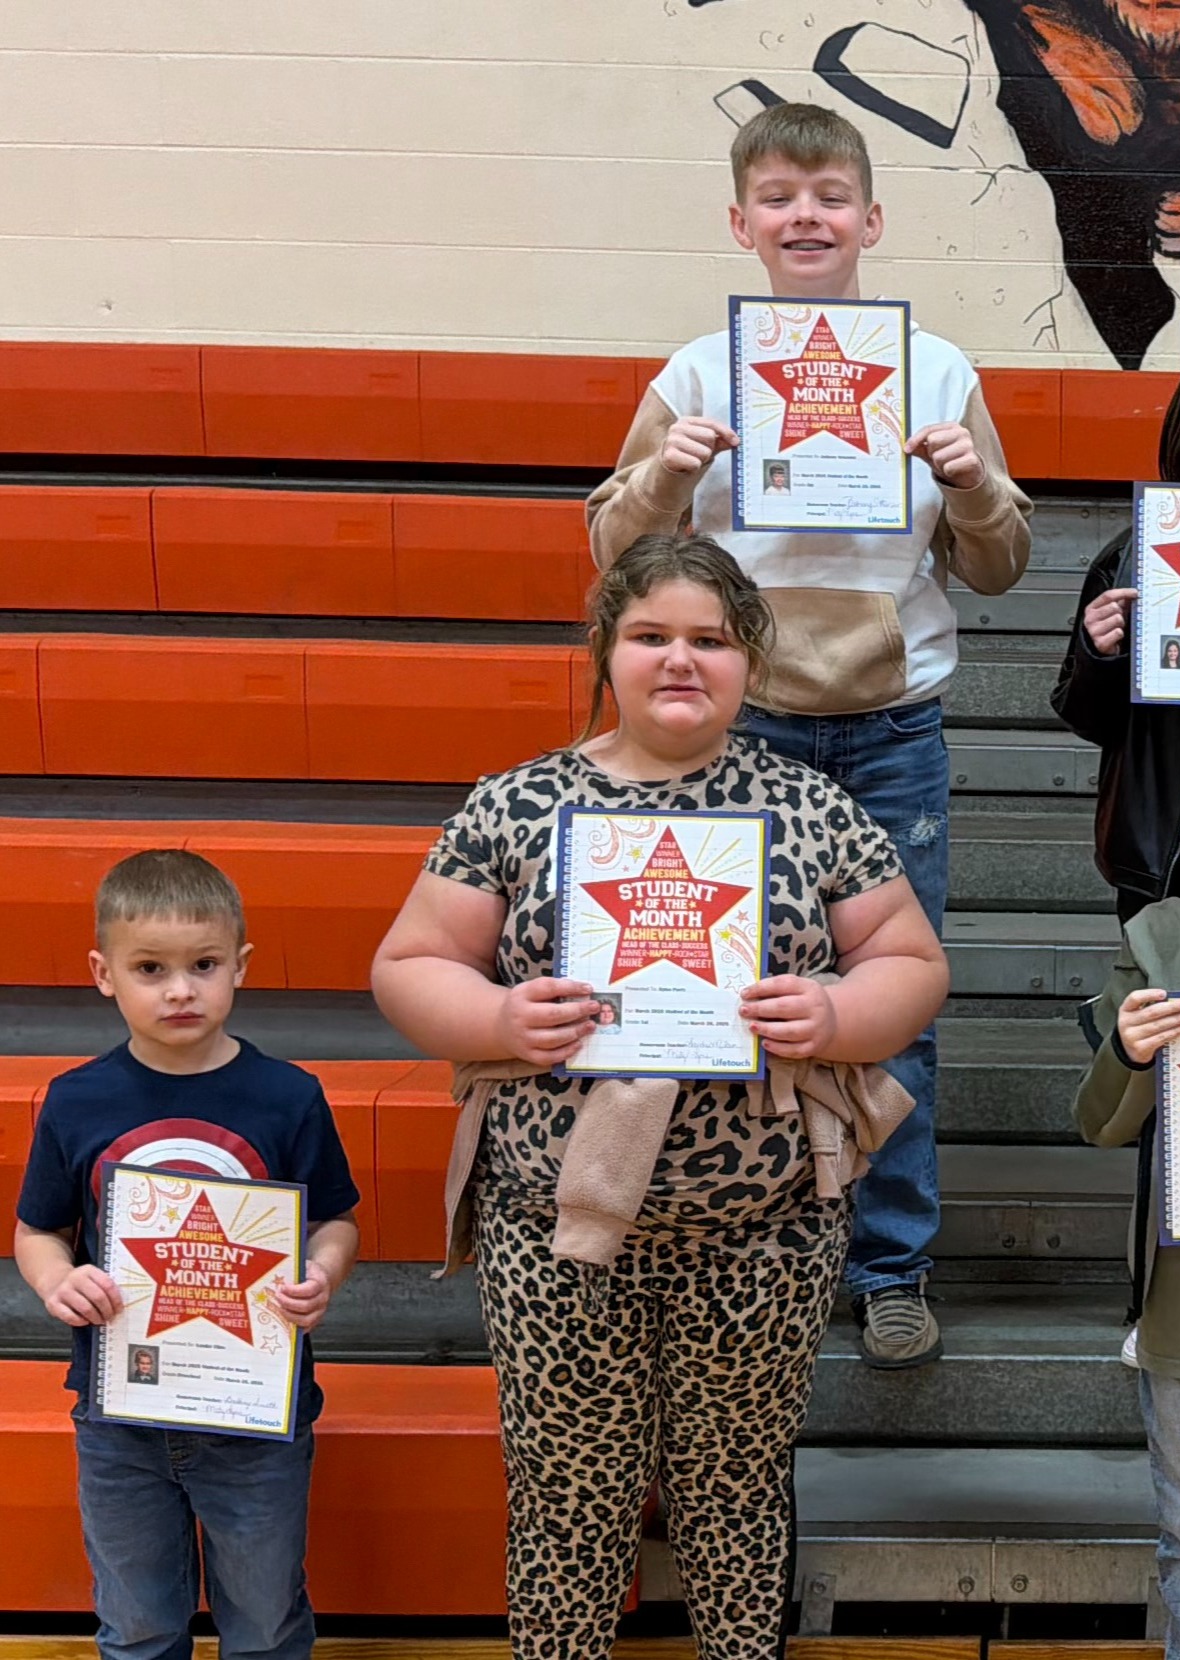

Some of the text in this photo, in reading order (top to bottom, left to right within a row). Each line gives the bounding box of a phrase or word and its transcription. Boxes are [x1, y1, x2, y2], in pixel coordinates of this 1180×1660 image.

[809, 341, 836, 350] BRIGHT
[802, 350, 841, 359] AWESOME
[781, 361, 866, 380] STUDENT
[804, 377, 842, 386] OF THE
[792, 387, 854, 402] MONTH
[788, 403, 858, 414] ACHIEVEMENT
[651, 858, 683, 867] BRIGHT
[643, 868, 688, 878] AWESOME
[618, 880, 718, 902] STUDENT
[644, 898, 688, 909] OF THE
[629, 910, 702, 927] MONTH
[623, 928, 705, 941] ACHIEVEMENT
[617, 958, 643, 967] SHINE
[682, 959, 711, 968] SWEET
[711, 1058, 751, 1067] Lifetouch
[186, 1220, 218, 1231] BRIGHT
[178, 1229, 223, 1242] AWESOME
[154, 1241, 253, 1265] STUDENT
[180, 1258, 223, 1271] OF THE
[165, 1268, 238, 1289] MONTH
[159, 1284, 241, 1302] ACHIEVEMENT
[154, 1312, 180, 1322] SHINE
[218, 1318, 248, 1329] SWEET
[245, 1416, 281, 1427] Lifetouch
